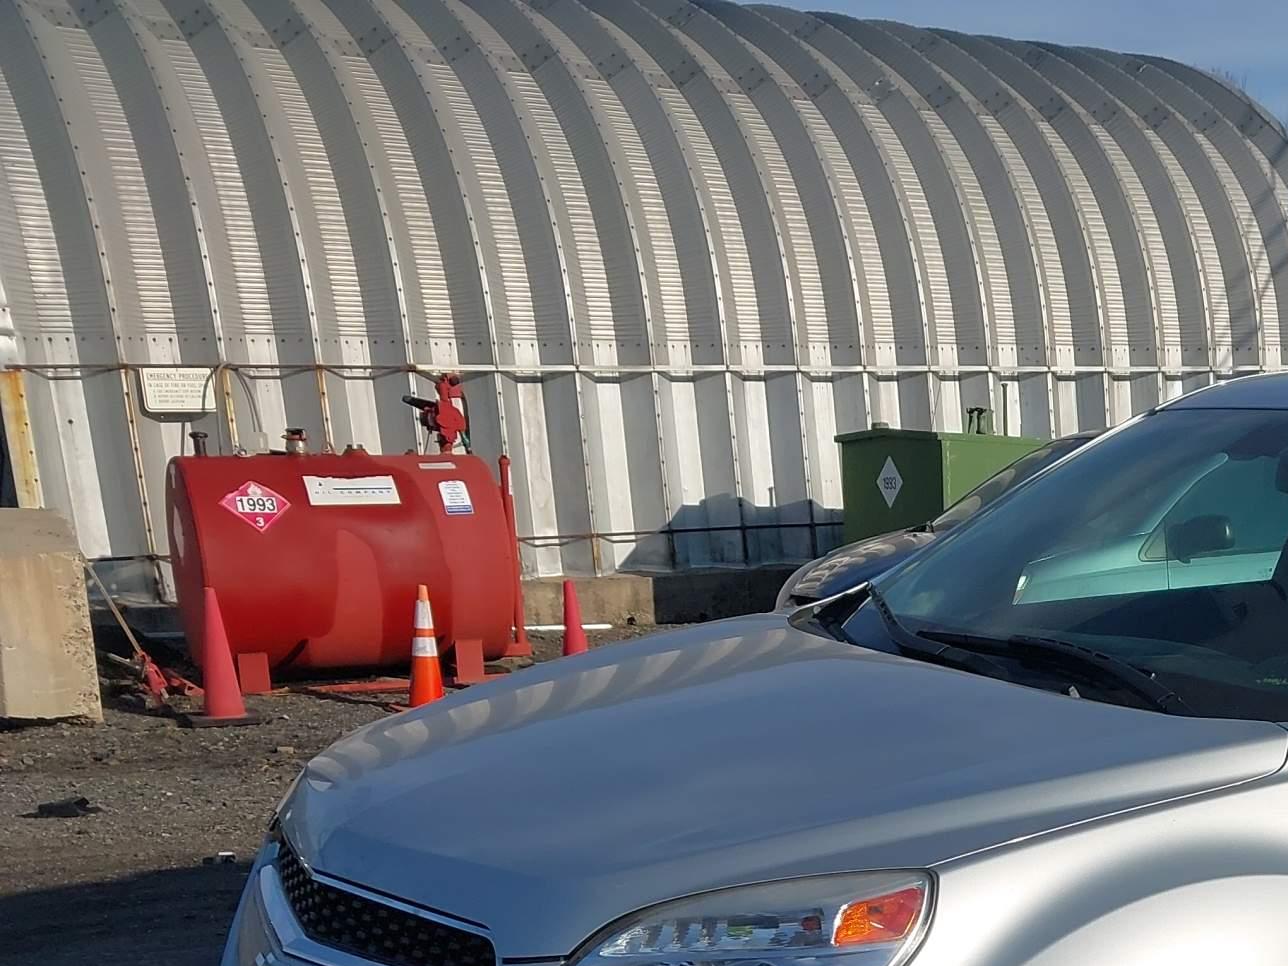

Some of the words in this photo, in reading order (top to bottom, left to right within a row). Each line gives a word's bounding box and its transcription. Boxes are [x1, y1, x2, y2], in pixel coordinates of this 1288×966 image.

[146, 372, 176, 381] EMERGENCY
[237, 498, 275, 511] 1993
[255, 516, 265, 527] 3
